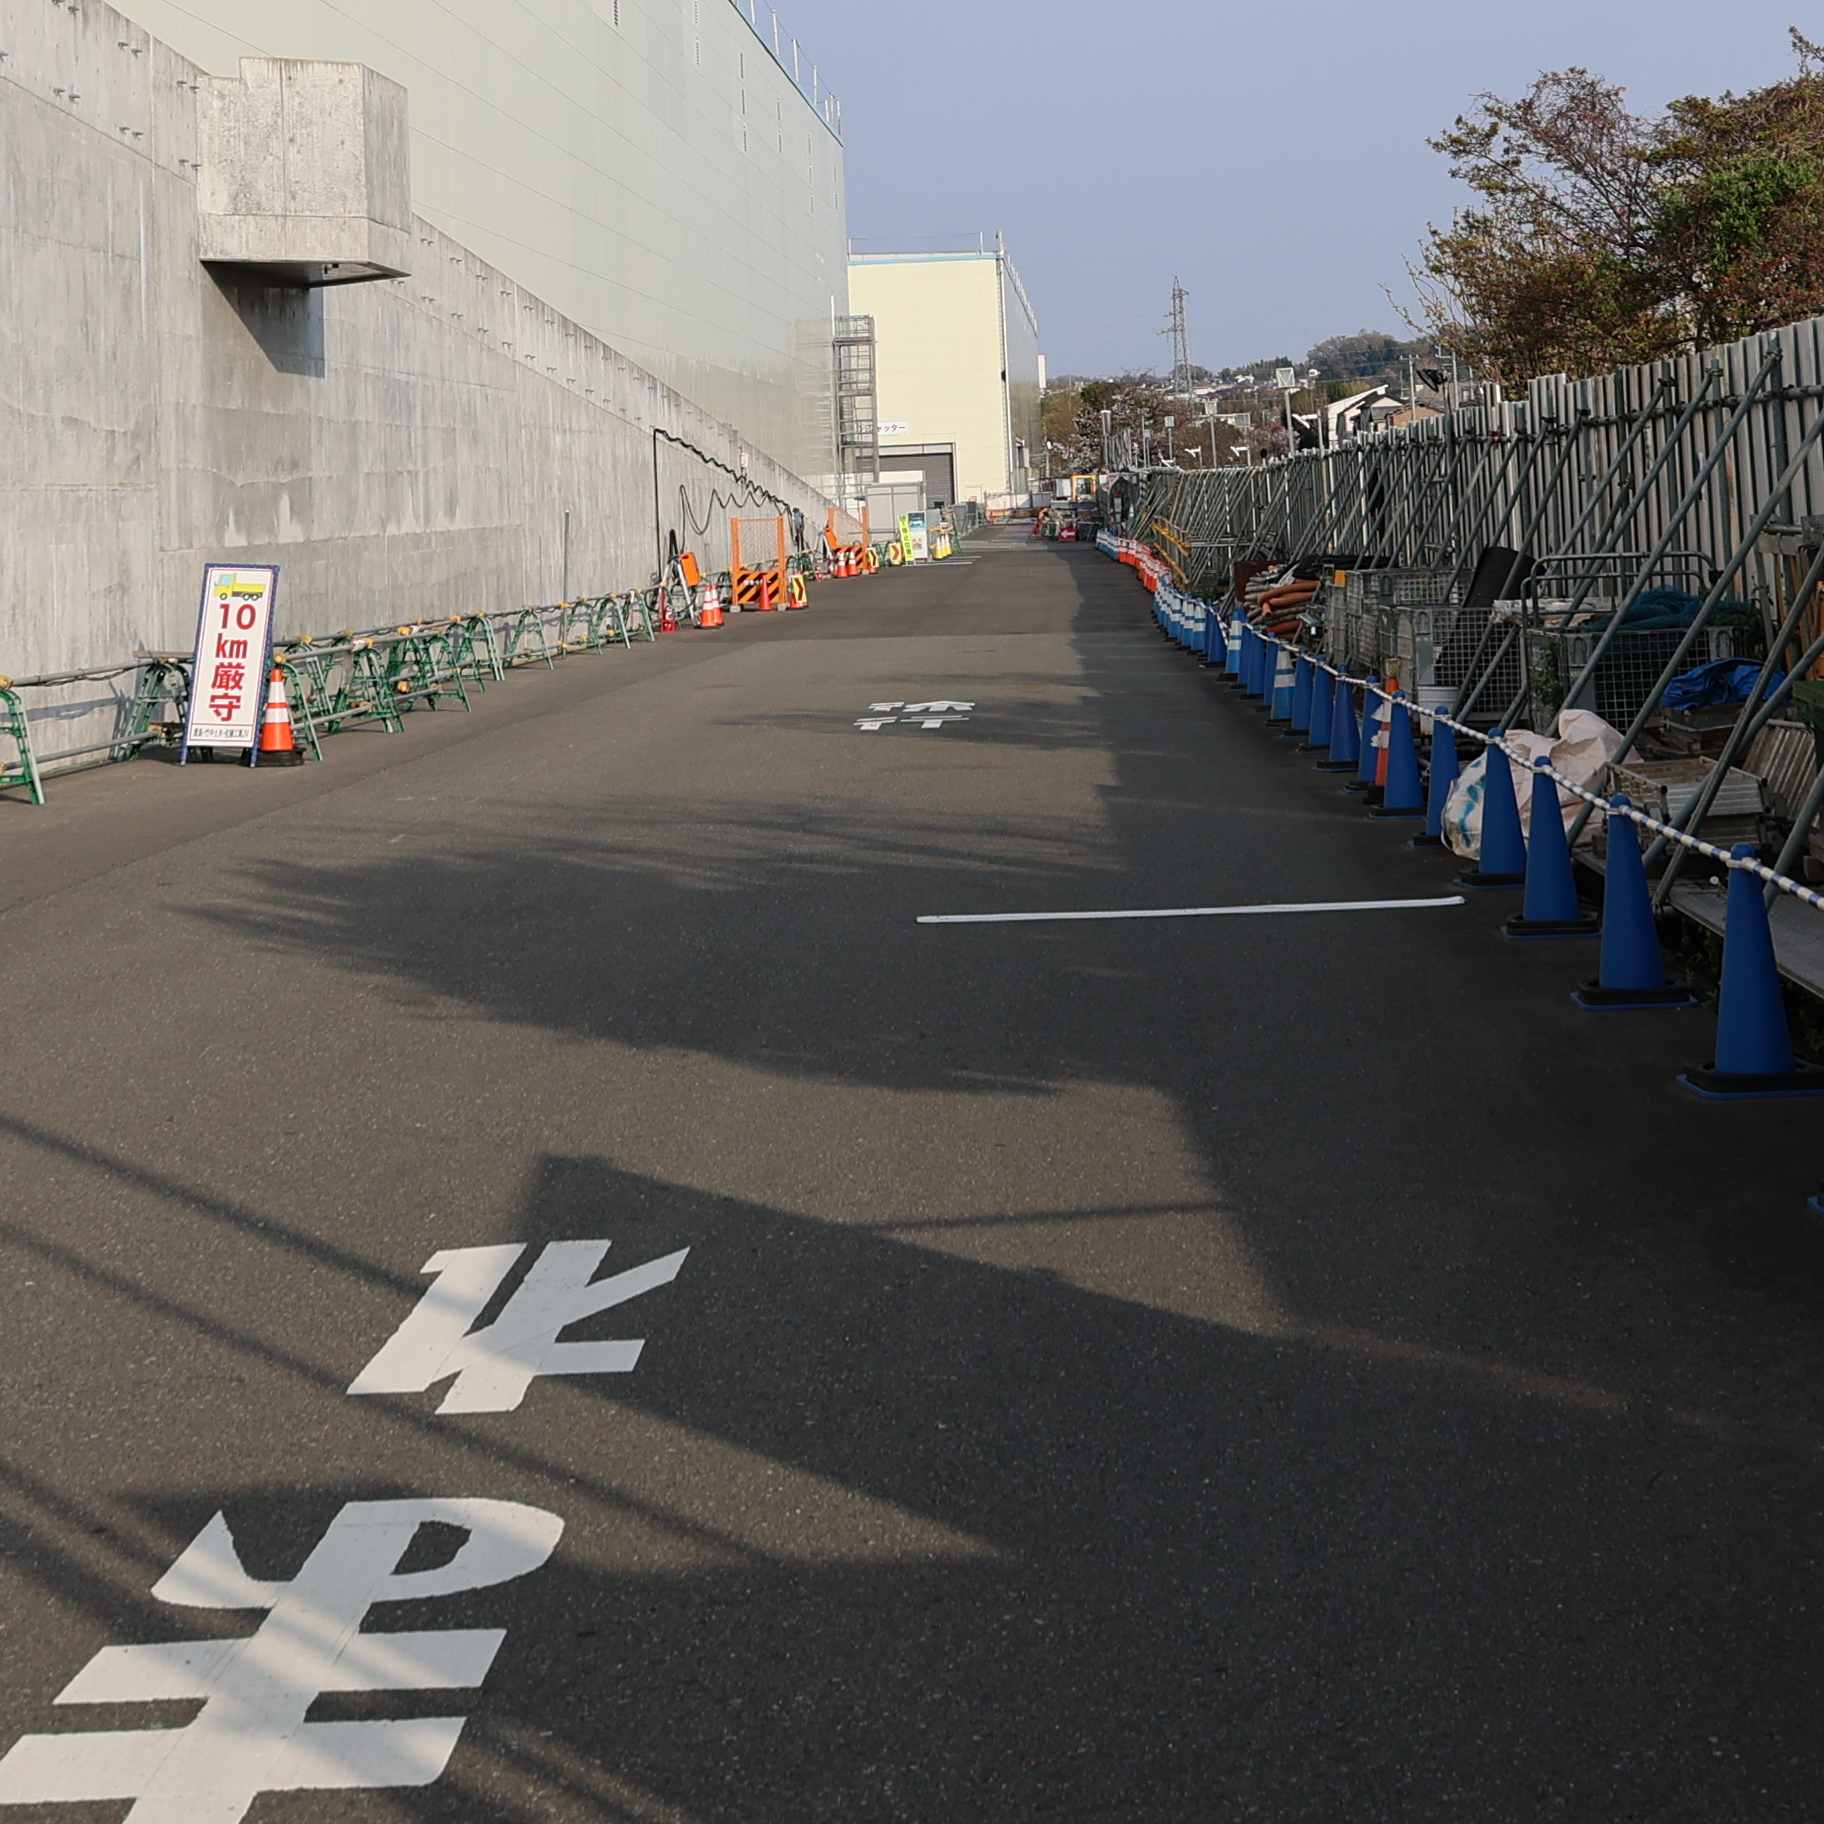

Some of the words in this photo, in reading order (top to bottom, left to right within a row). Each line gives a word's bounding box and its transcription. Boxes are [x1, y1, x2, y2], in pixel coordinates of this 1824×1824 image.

[219, 603, 256, 630] 10
[215, 632, 248, 659] km
[208, 662, 246, 722] 厳守
